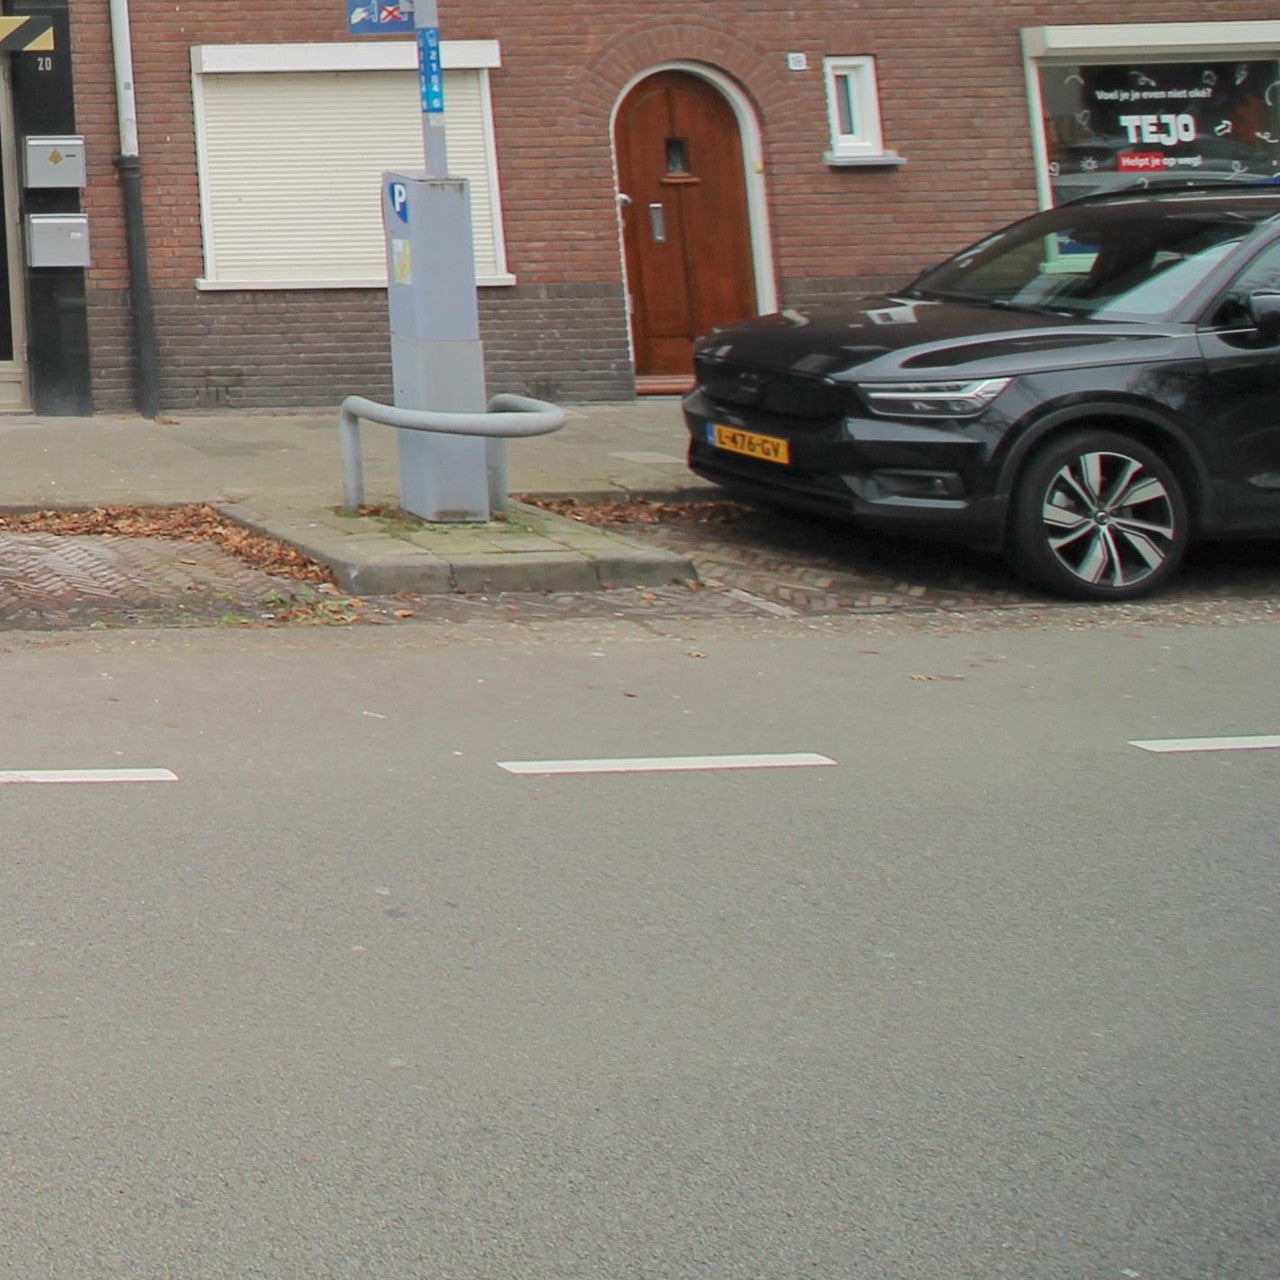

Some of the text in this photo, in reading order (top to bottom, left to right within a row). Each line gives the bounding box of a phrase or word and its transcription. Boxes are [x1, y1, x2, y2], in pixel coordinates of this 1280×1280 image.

[37, 57, 52, 71] 20
[1119, 89, 1130, 101] je
[1130, 89, 1141, 101] je
[1142, 91, 1166, 99] even
[1167, 89, 1188, 98] niet
[1120, 114, 1197, 146] TEJO
[1121, 156, 1150, 167] Helpt
[1150, 156, 1161, 167] je
[1161, 158, 1177, 167] op
[393, 183, 407, 212] P
